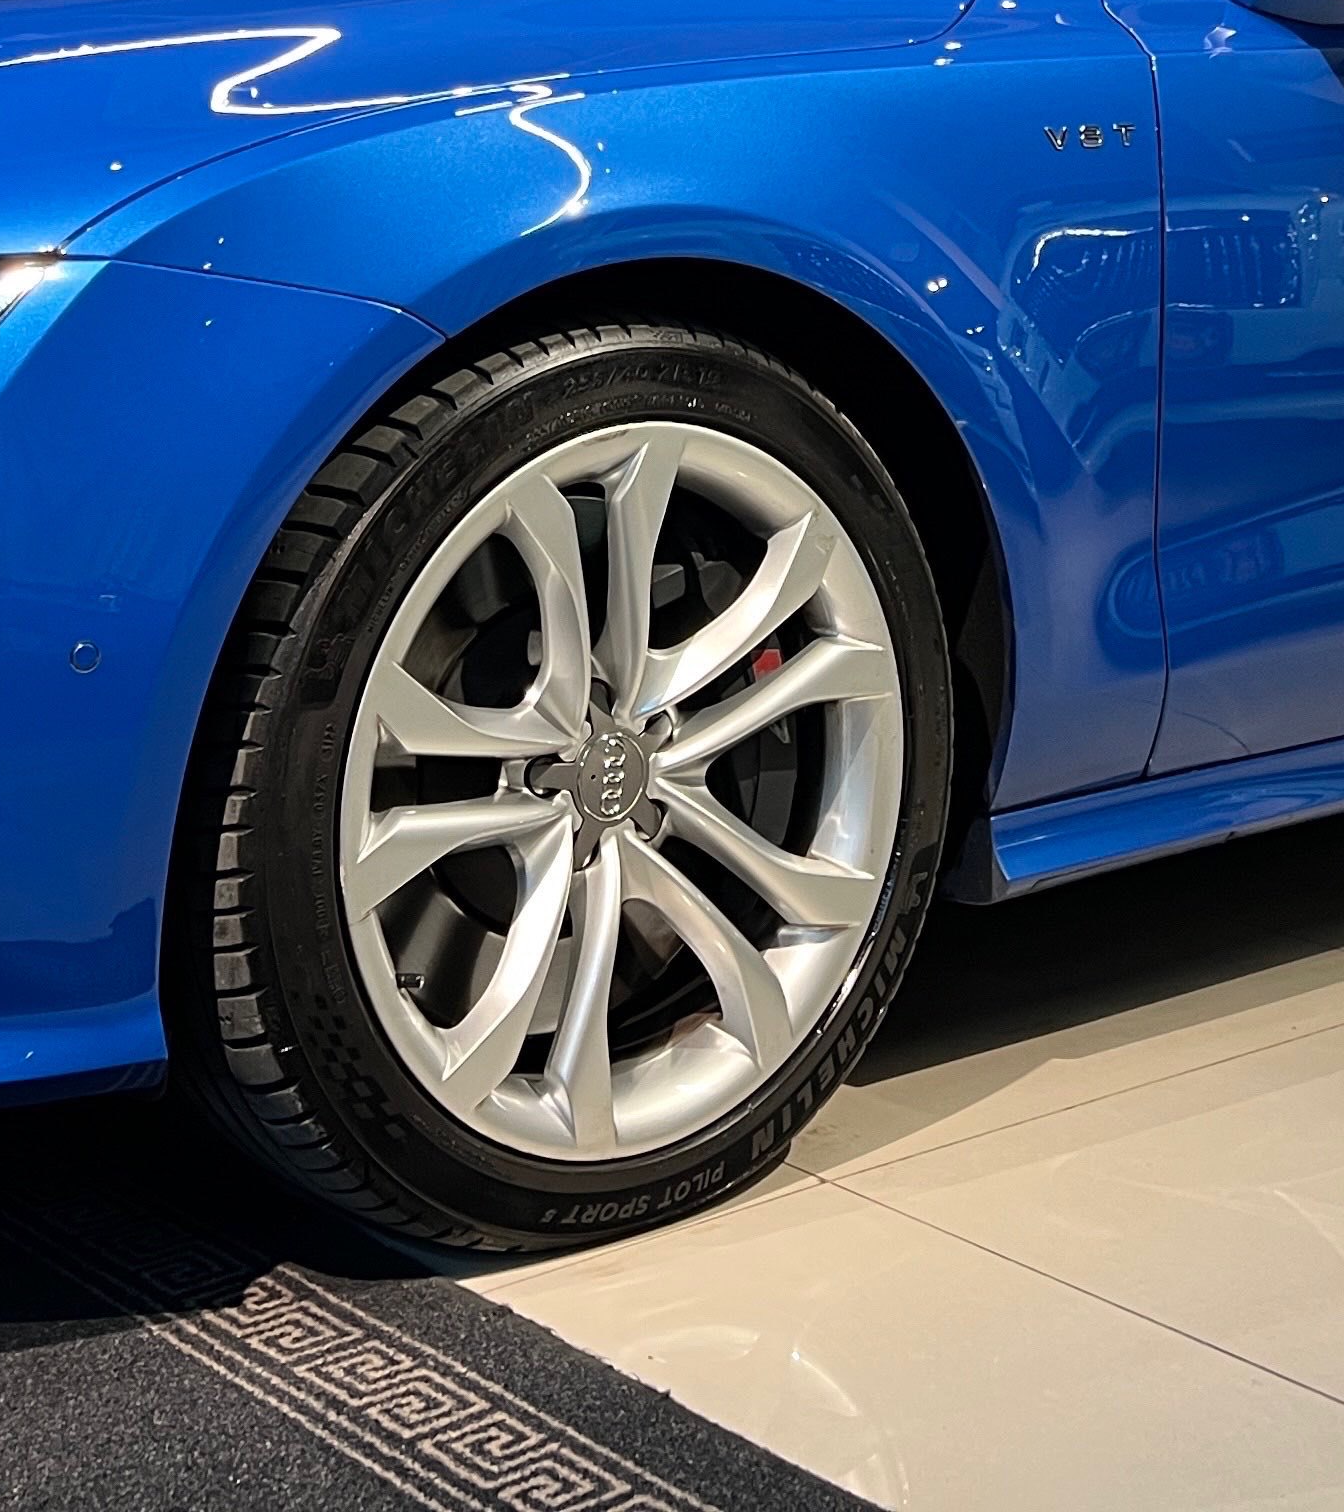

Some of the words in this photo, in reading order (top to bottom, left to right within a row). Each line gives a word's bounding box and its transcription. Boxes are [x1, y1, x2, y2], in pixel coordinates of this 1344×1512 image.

[751, 925, 910, 1159] MICHELIN
[560, 1194, 652, 1225] SPORT
[657, 1159, 726, 1210] PILOT
